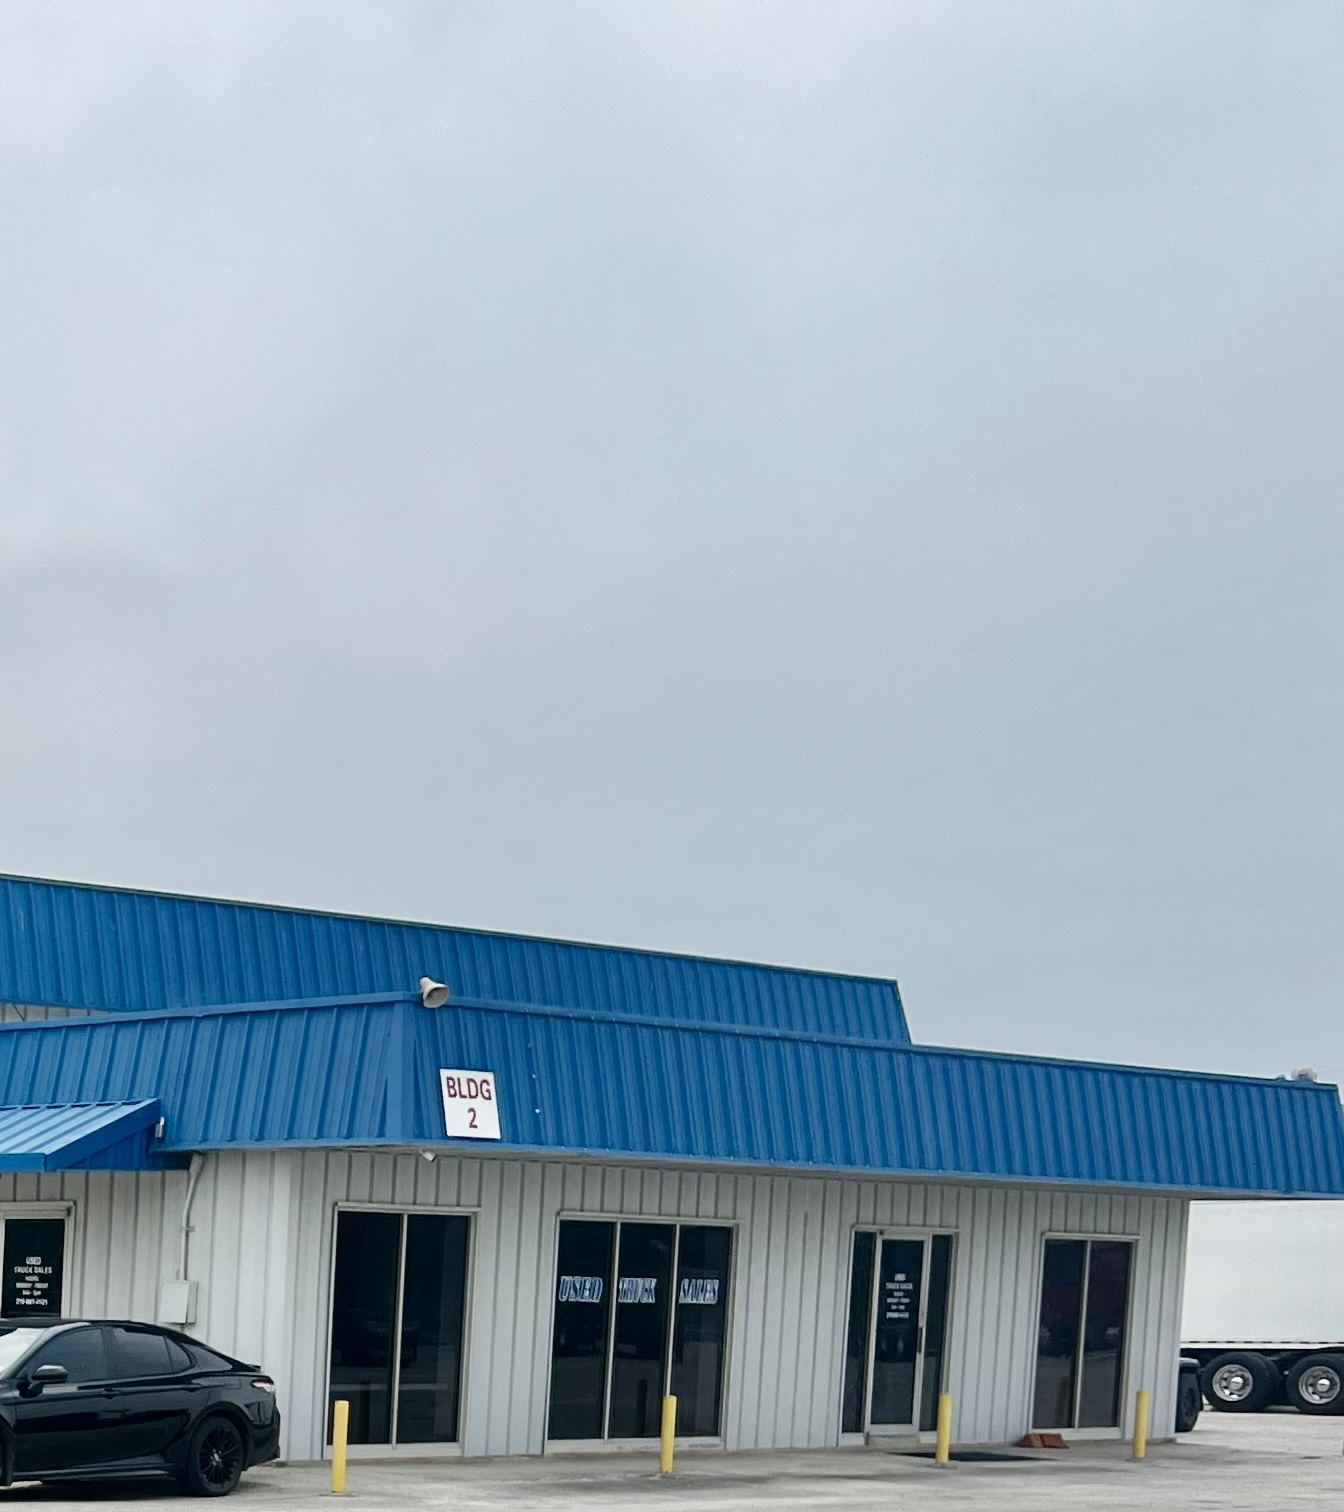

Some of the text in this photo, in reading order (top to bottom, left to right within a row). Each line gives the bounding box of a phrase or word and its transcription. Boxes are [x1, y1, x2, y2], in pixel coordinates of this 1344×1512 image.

[445, 1076, 492, 1101] BLDG
[467, 1107, 478, 1129] 2
[13, 1266, 33, 1274] TRUCK
[558, 1275, 720, 1305] USED TRUCK SALES
